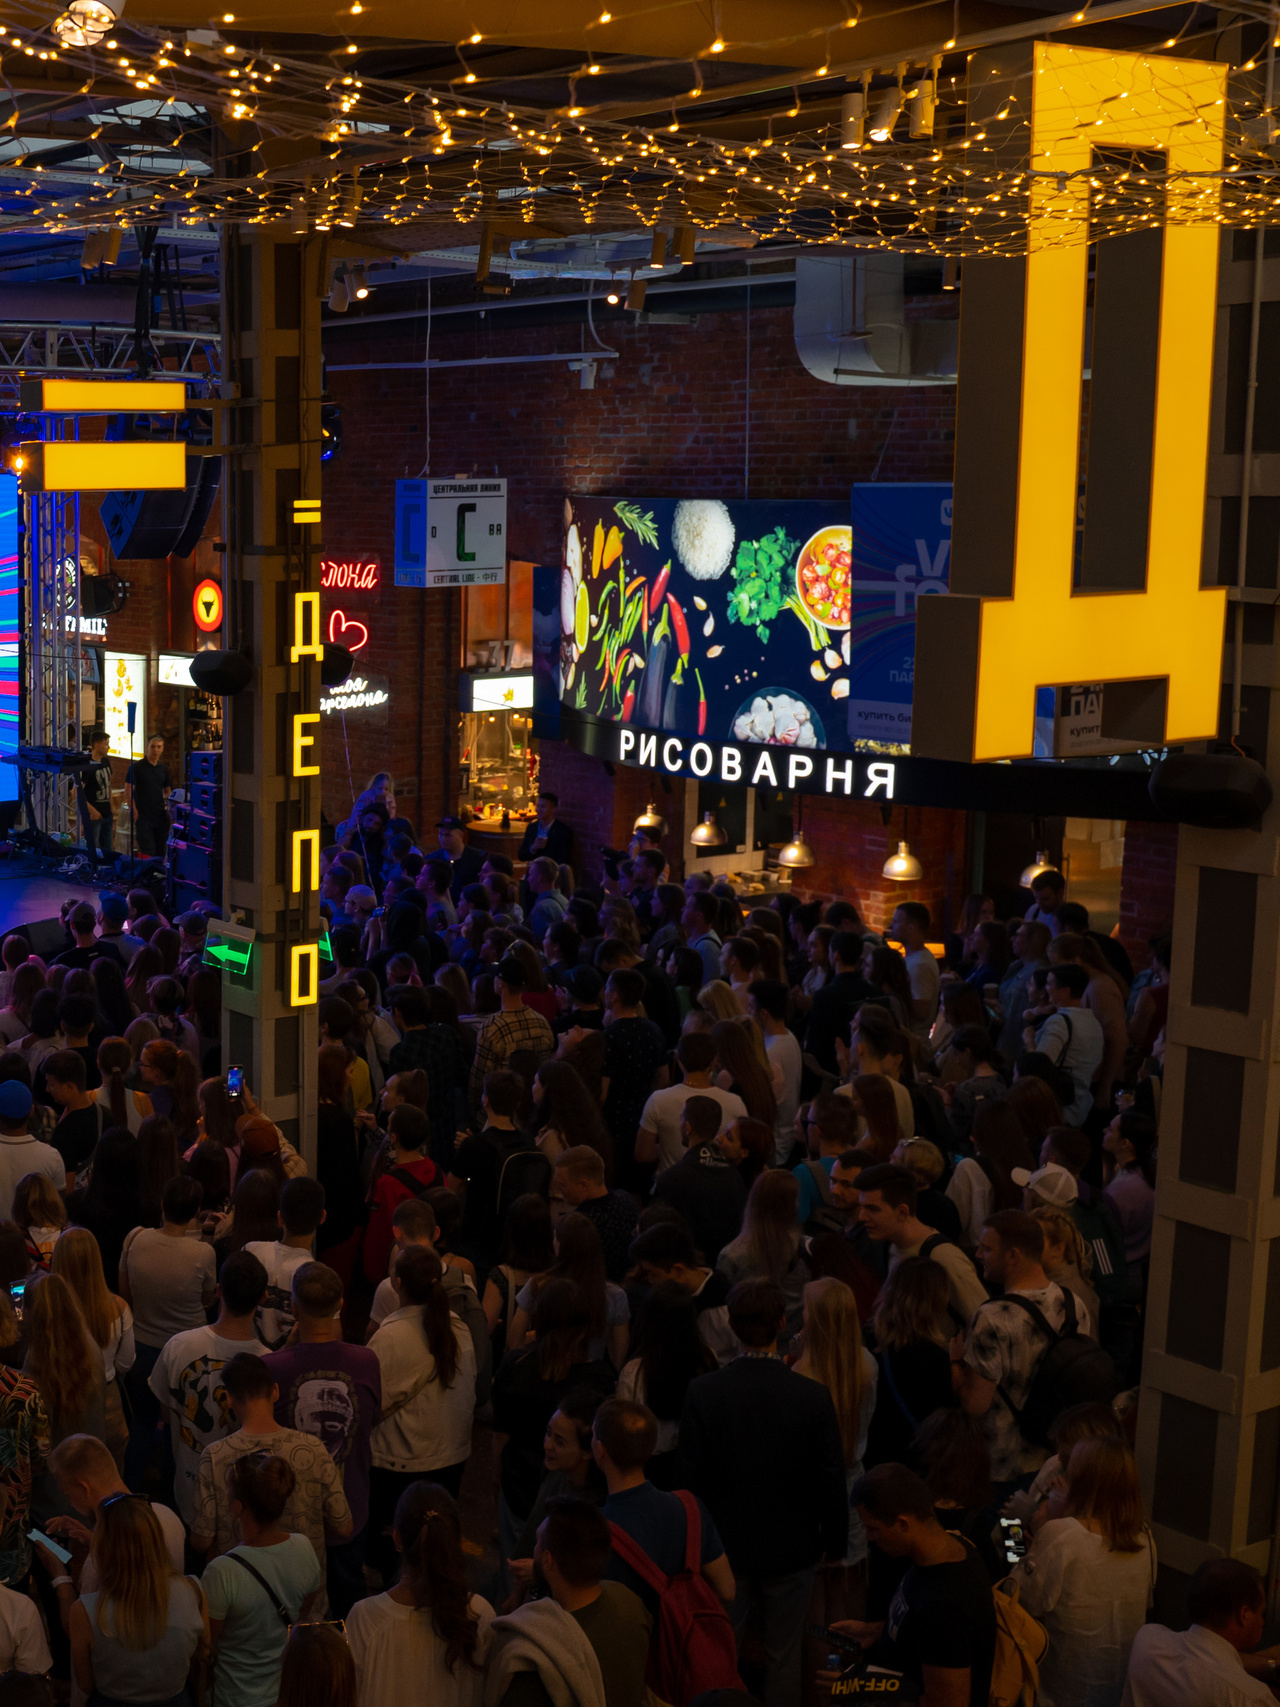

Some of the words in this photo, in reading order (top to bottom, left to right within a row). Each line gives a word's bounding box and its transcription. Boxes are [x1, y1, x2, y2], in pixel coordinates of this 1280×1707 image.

[433, 484, 478, 495] ЦЕНТРАЛЬНАЯ
[480, 483, 501, 492] ЛИНИЯ
[433, 574, 460, 584] CENTRAL
[462, 573, 475, 583] LINE
[857, 711, 896, 721] купить
[619, 728, 896, 799] РИСОВАРНЯ
